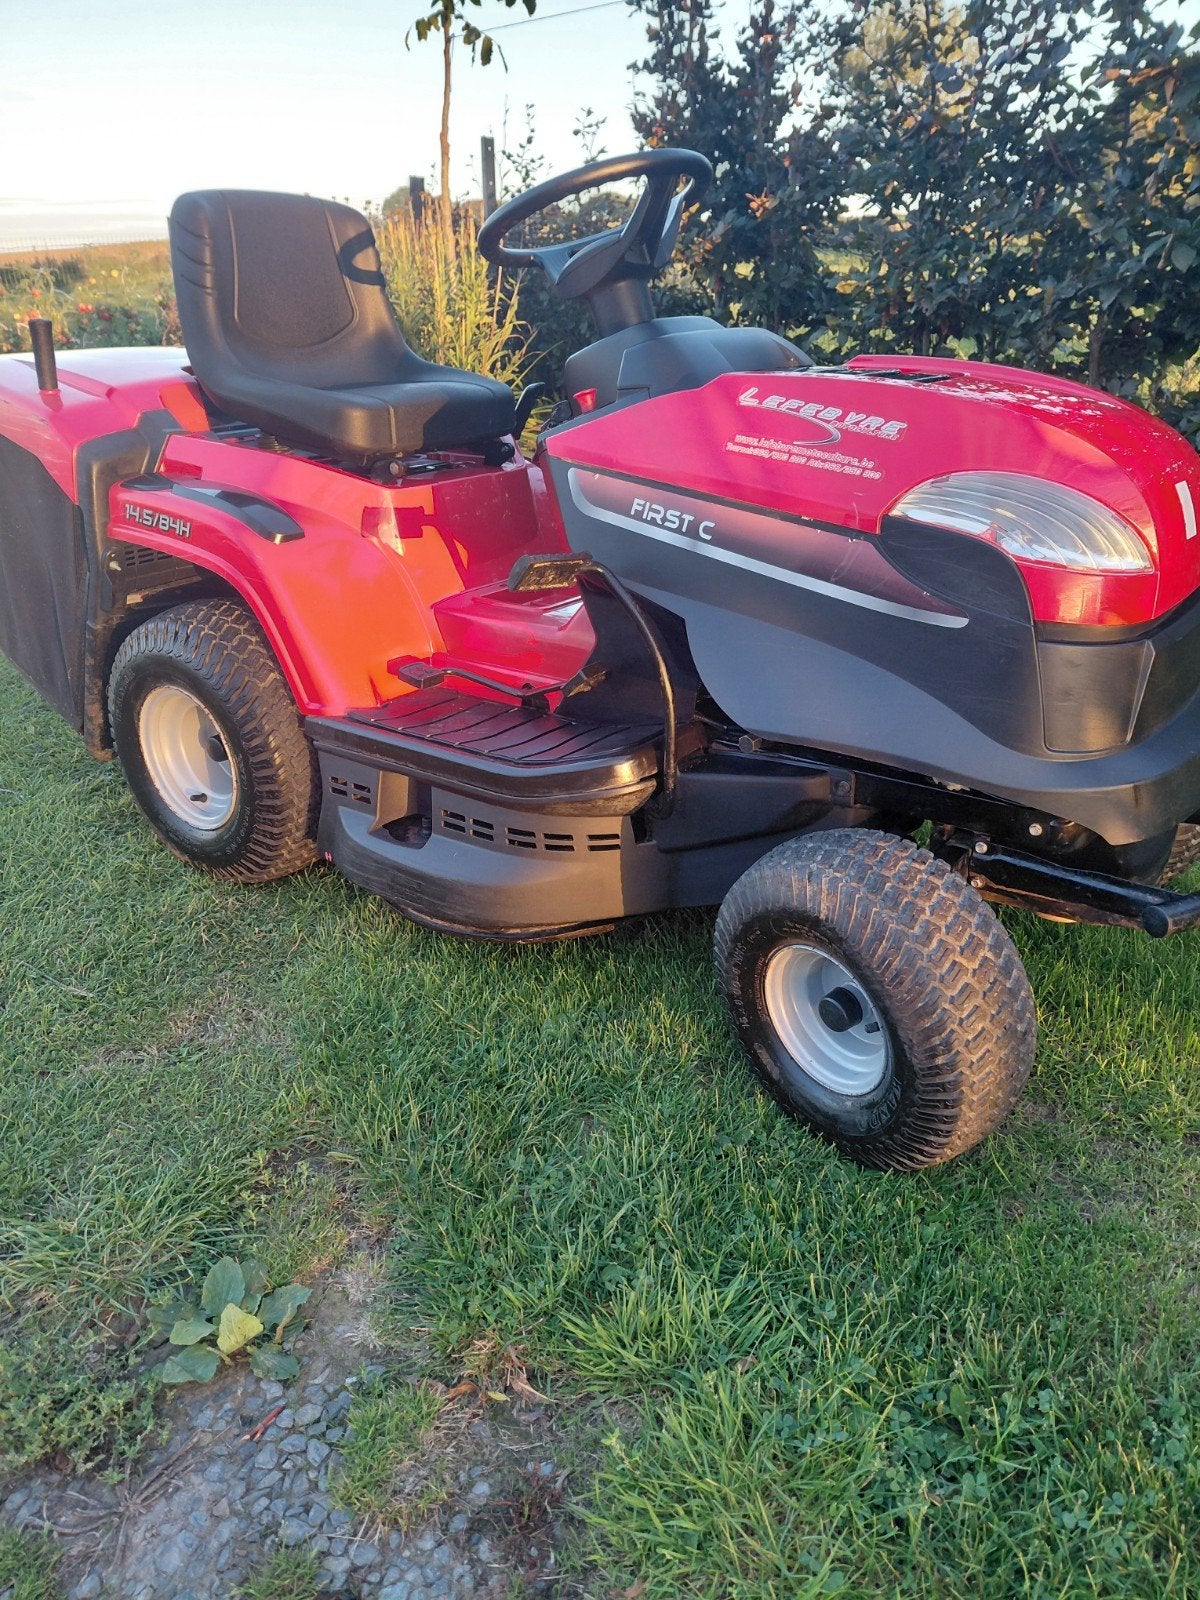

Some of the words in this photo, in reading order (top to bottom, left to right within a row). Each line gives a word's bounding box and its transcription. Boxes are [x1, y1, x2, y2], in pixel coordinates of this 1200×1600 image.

[738, 387, 907, 434] LEFEBVRE
[125, 503, 191, 538] 14.5/84H
[630, 498, 695, 533] FIRST
[698, 521, 716, 541] C
